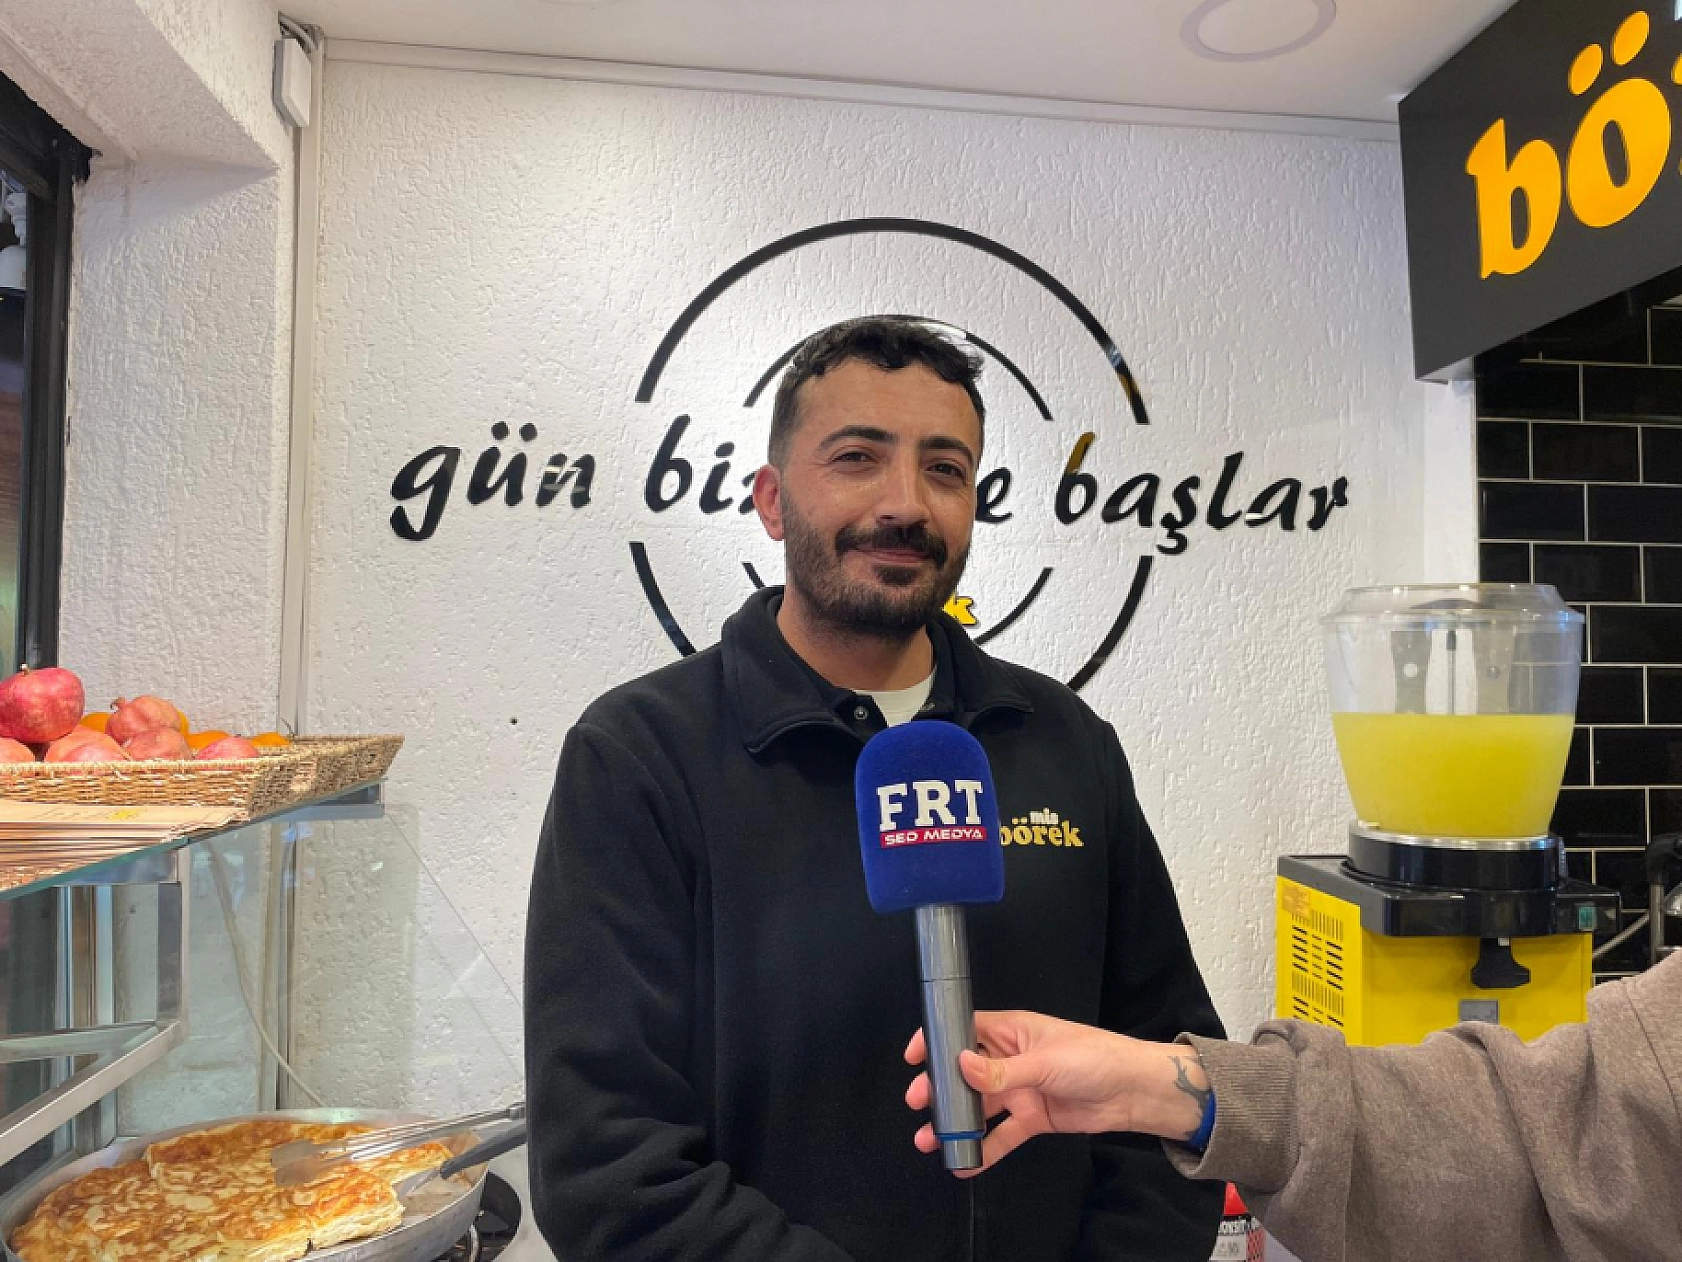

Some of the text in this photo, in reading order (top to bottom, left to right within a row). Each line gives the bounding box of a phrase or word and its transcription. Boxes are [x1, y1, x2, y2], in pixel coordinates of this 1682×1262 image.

[1465, 11, 1682, 279] bö
[389, 421, 595, 541] gün
[1055, 432, 1348, 555] başlar
[877, 780, 983, 832] FRT
[923, 828, 983, 841] MEDYA
